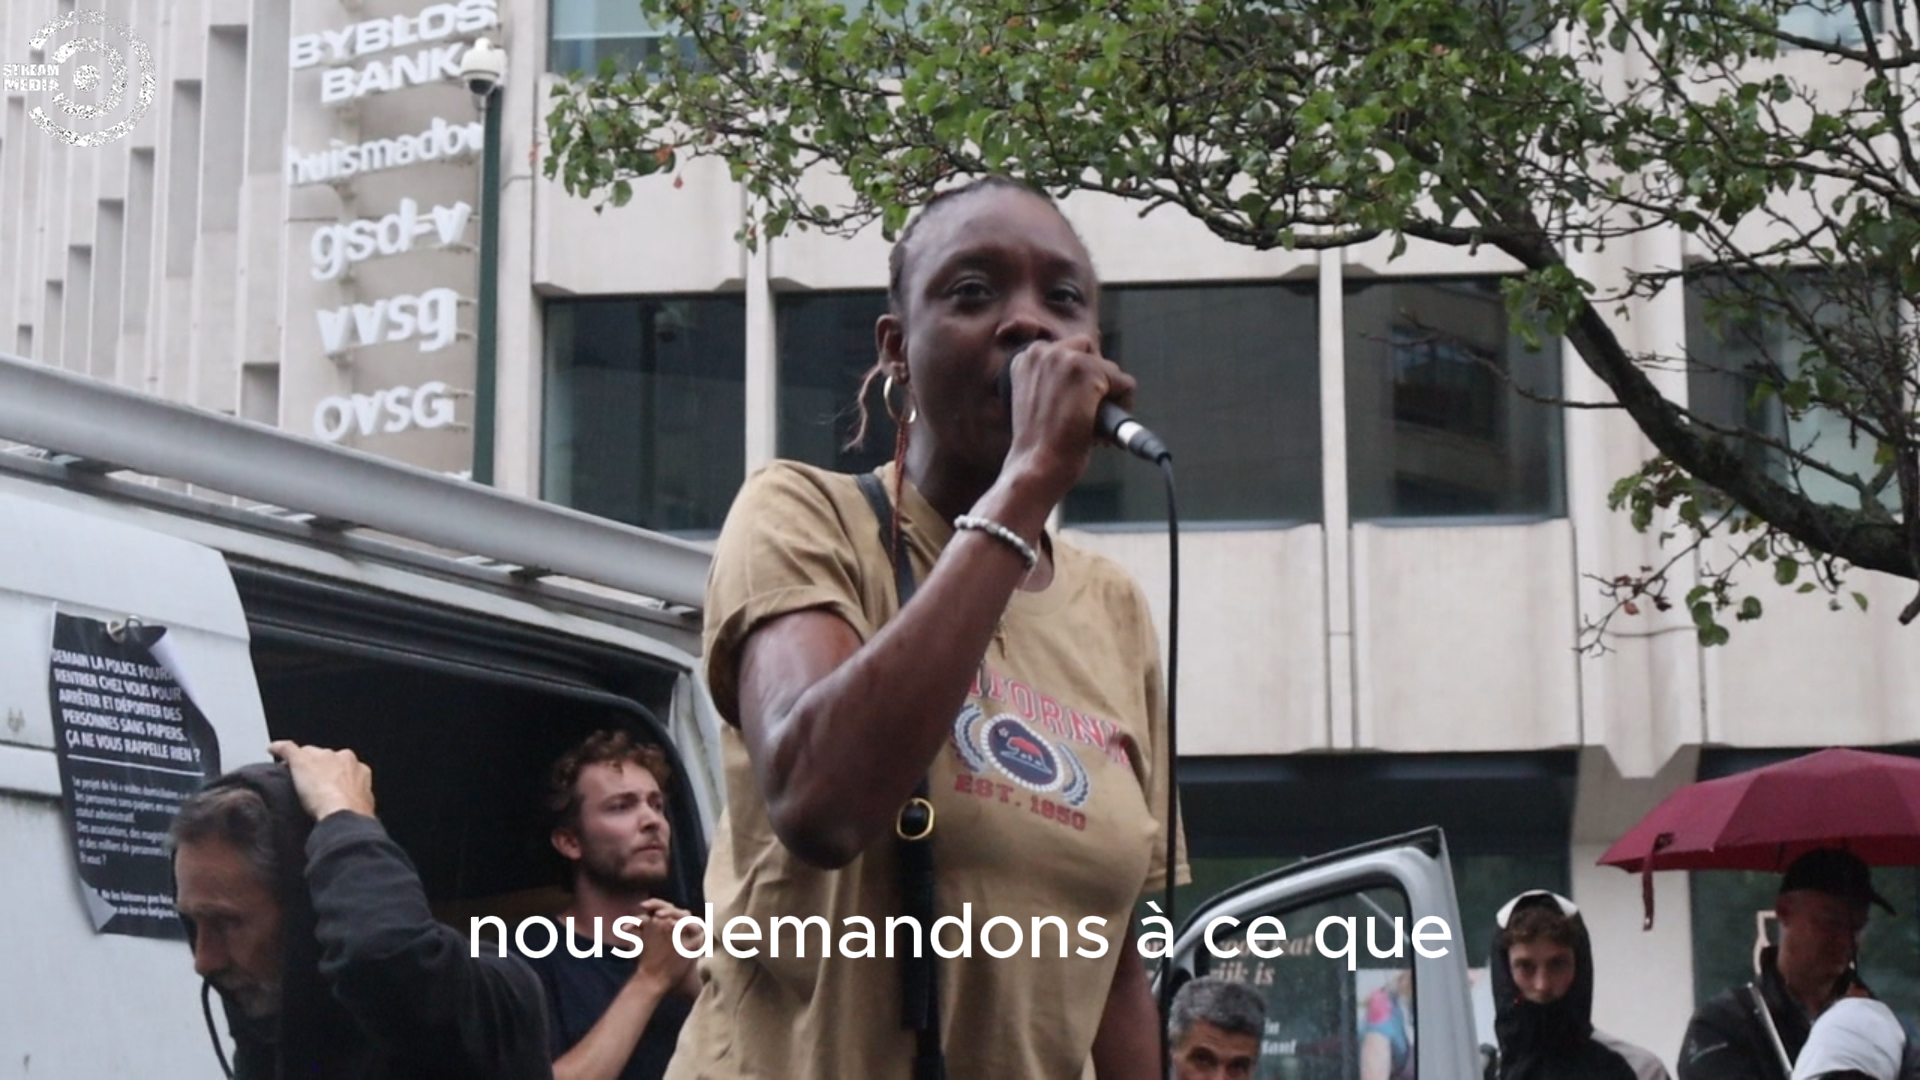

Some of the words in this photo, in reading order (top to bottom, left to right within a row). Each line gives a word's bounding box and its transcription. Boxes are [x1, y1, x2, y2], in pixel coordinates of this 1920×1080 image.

[290, 0, 498, 69] BYBLOS
[321, 42, 466, 103] BANK
[310, 198, 471, 280] gsd-v
[316, 288, 459, 354] vvsg
[90, 655, 105, 670] LA
[105, 658, 137, 677] POLICE
[54, 668, 98, 688] RENTRER
[99, 675, 123, 693] CHEZ
[123, 680, 150, 697] VOUS
[151, 685, 182, 702] POUR
[59, 688, 101, 709] ARRÊTER
[102, 695, 115, 710] ET
[114, 697, 162, 719] DÉPORTER
[163, 706, 183, 722] DES
[62, 709, 119, 731] PERSONNES
[120, 718, 146, 735] SANS
[65, 729, 80, 749] ÇA
[81, 732, 95, 748] NE
[96, 734, 123, 752] VOUS
[124, 738, 169, 759] RAPPELLE
[170, 746, 192, 762] RIEN
[1030, 795, 1087, 832] 1850
